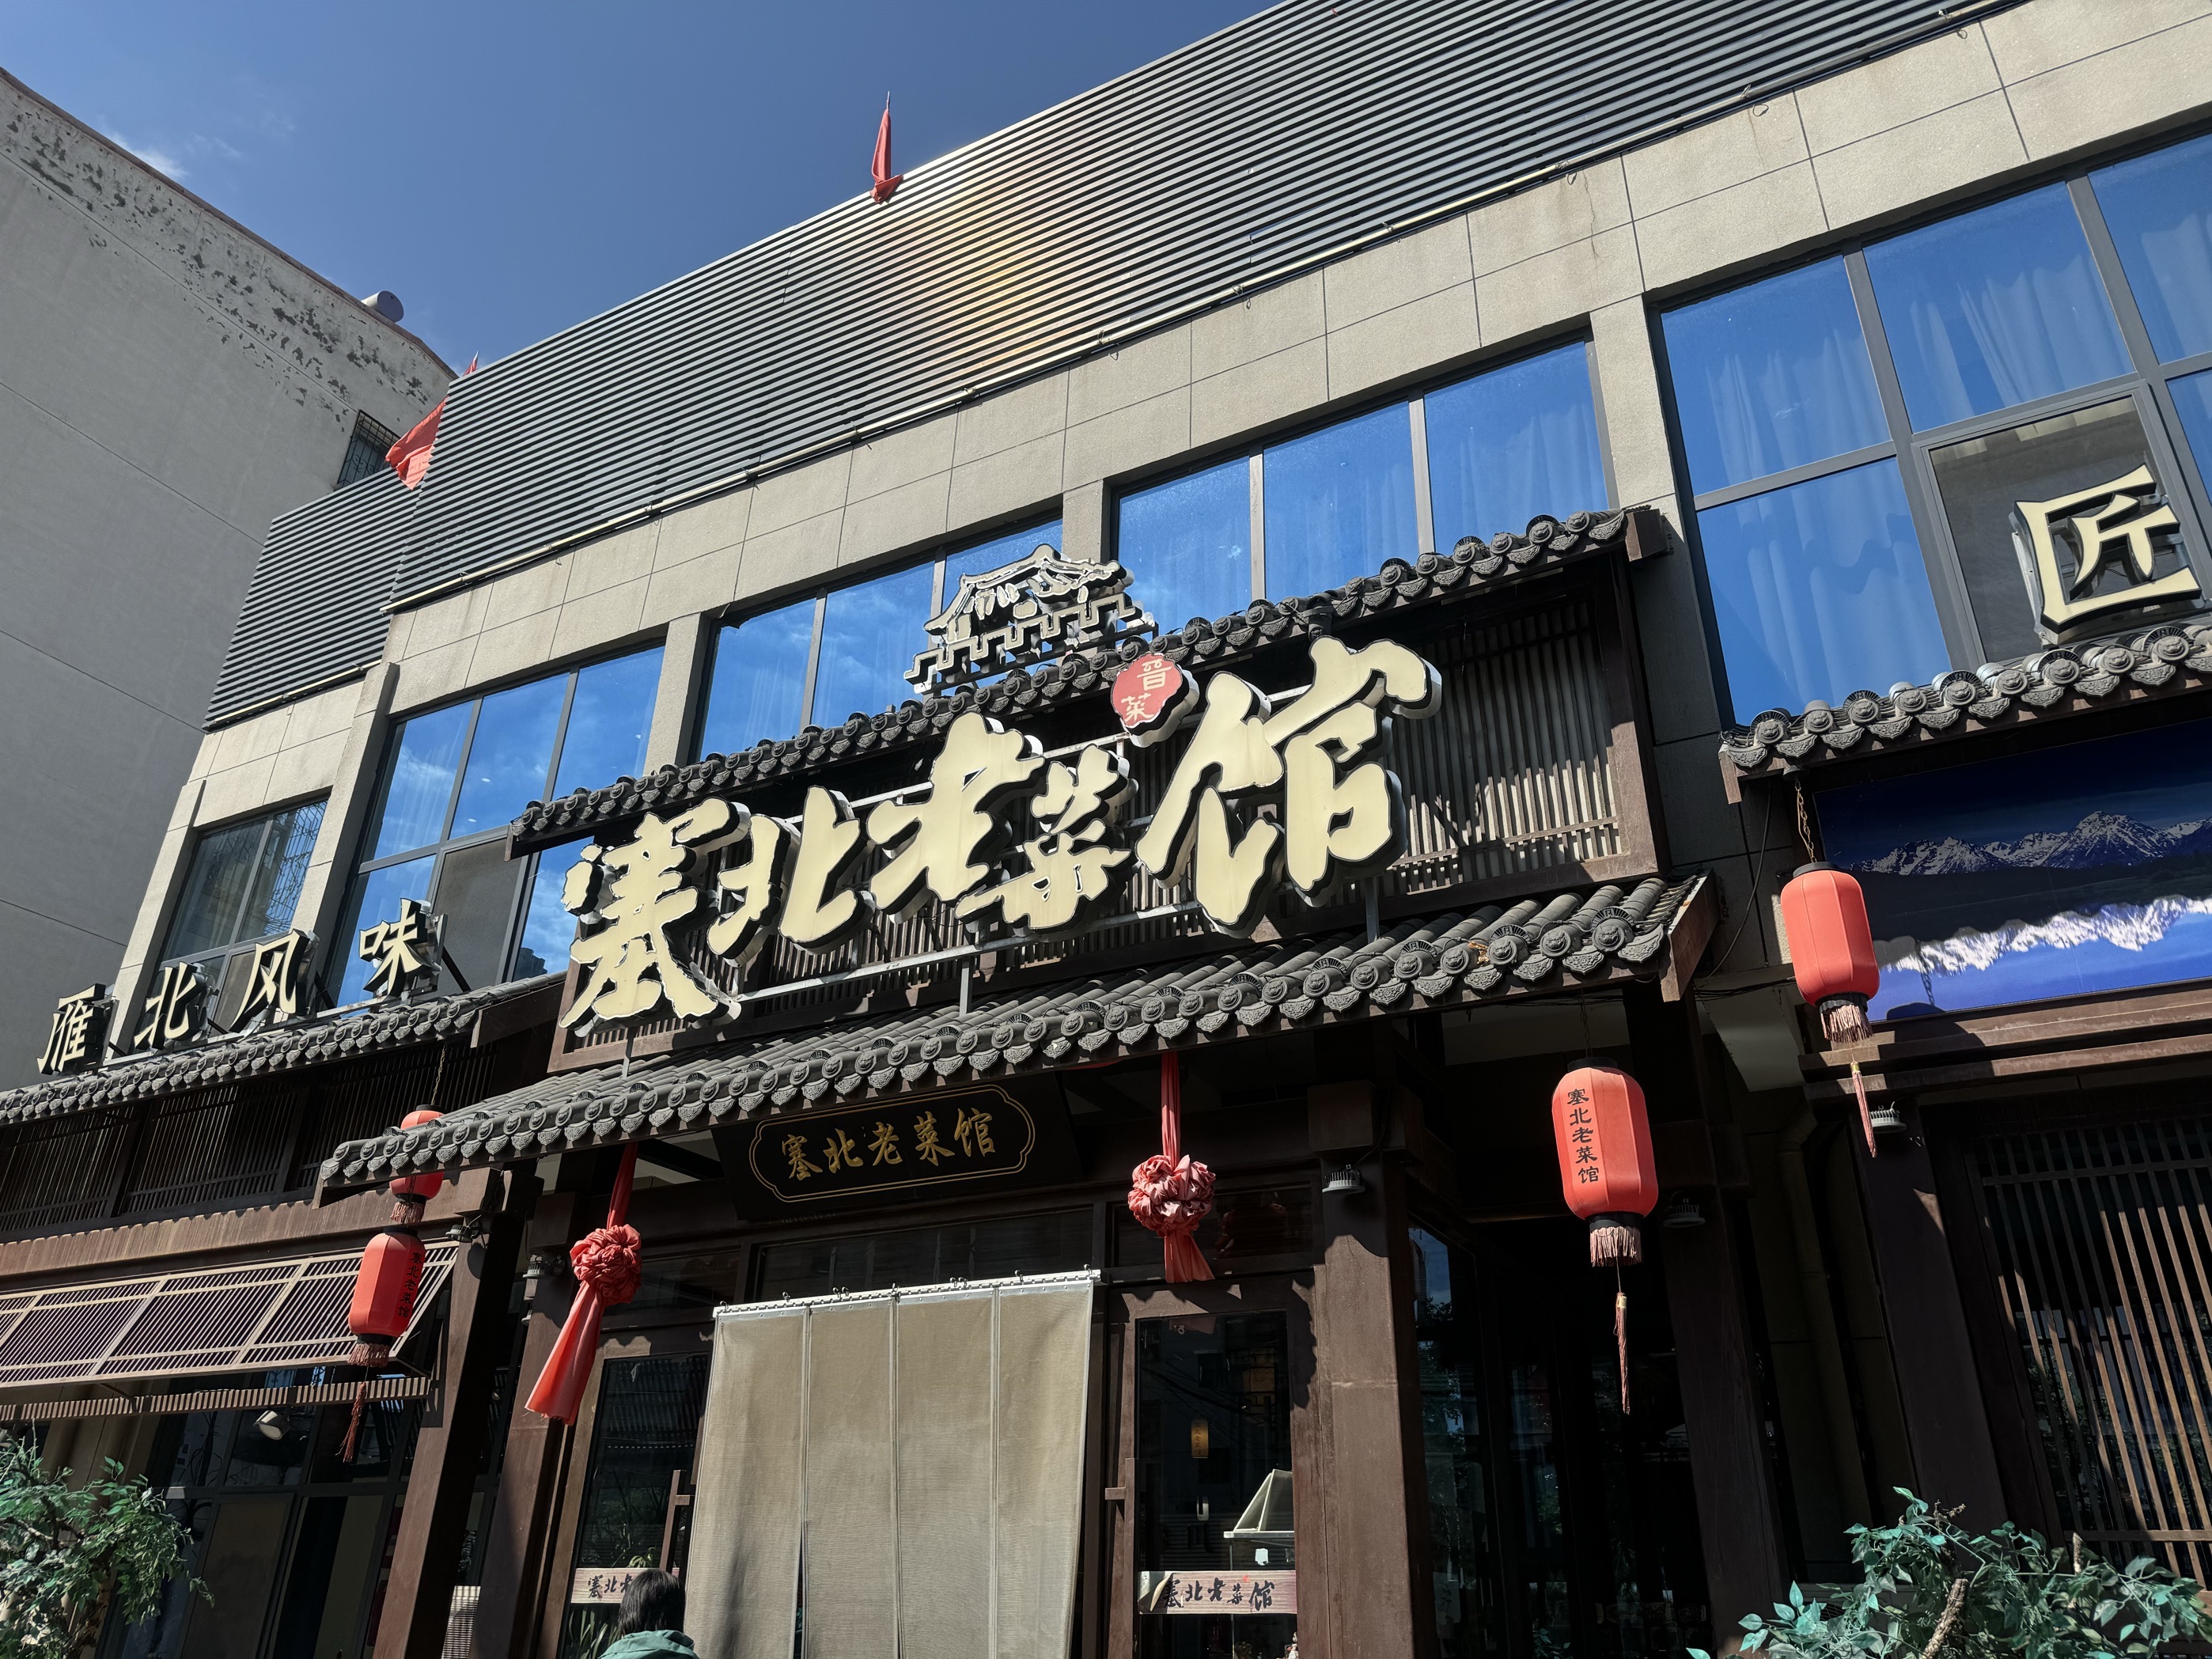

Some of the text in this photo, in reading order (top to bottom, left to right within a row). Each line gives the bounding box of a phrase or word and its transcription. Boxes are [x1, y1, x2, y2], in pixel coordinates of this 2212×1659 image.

[2016, 464, 2201, 628] 匠
[1121, 659, 1172, 722] 晋菜
[559, 637, 1427, 1028] 塞北老菜馆
[37, 899, 427, 1074] 雁北风味
[781, 1108, 995, 1180] 塞北老菜馆
[1567, 1089, 1598, 1184] 塞北老菜馆
[398, 1252, 422, 1319] 塞北老菜馆
[1165, 1578, 1275, 1611] 塞北老菜馆
